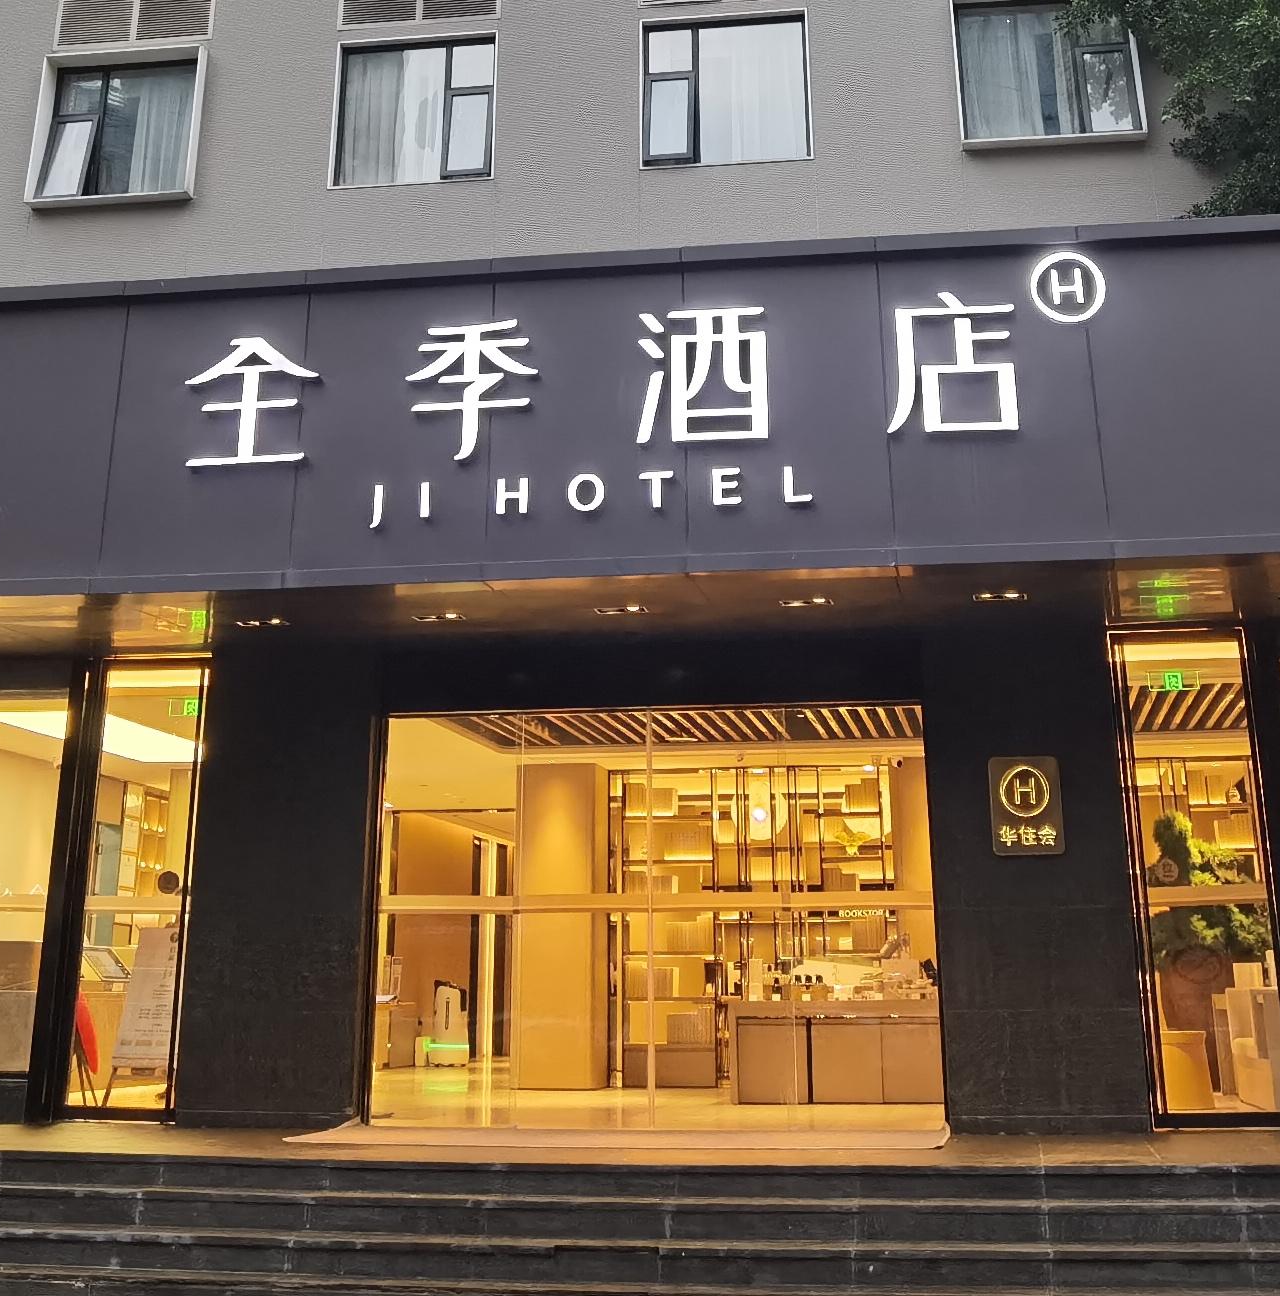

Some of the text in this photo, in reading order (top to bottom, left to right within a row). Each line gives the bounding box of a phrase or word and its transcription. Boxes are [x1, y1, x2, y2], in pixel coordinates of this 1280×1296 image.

[183, 290, 1022, 468] 全季酒店
[369, 464, 815, 530] JI HOTEL
[998, 824, 1058, 847] 华住会
